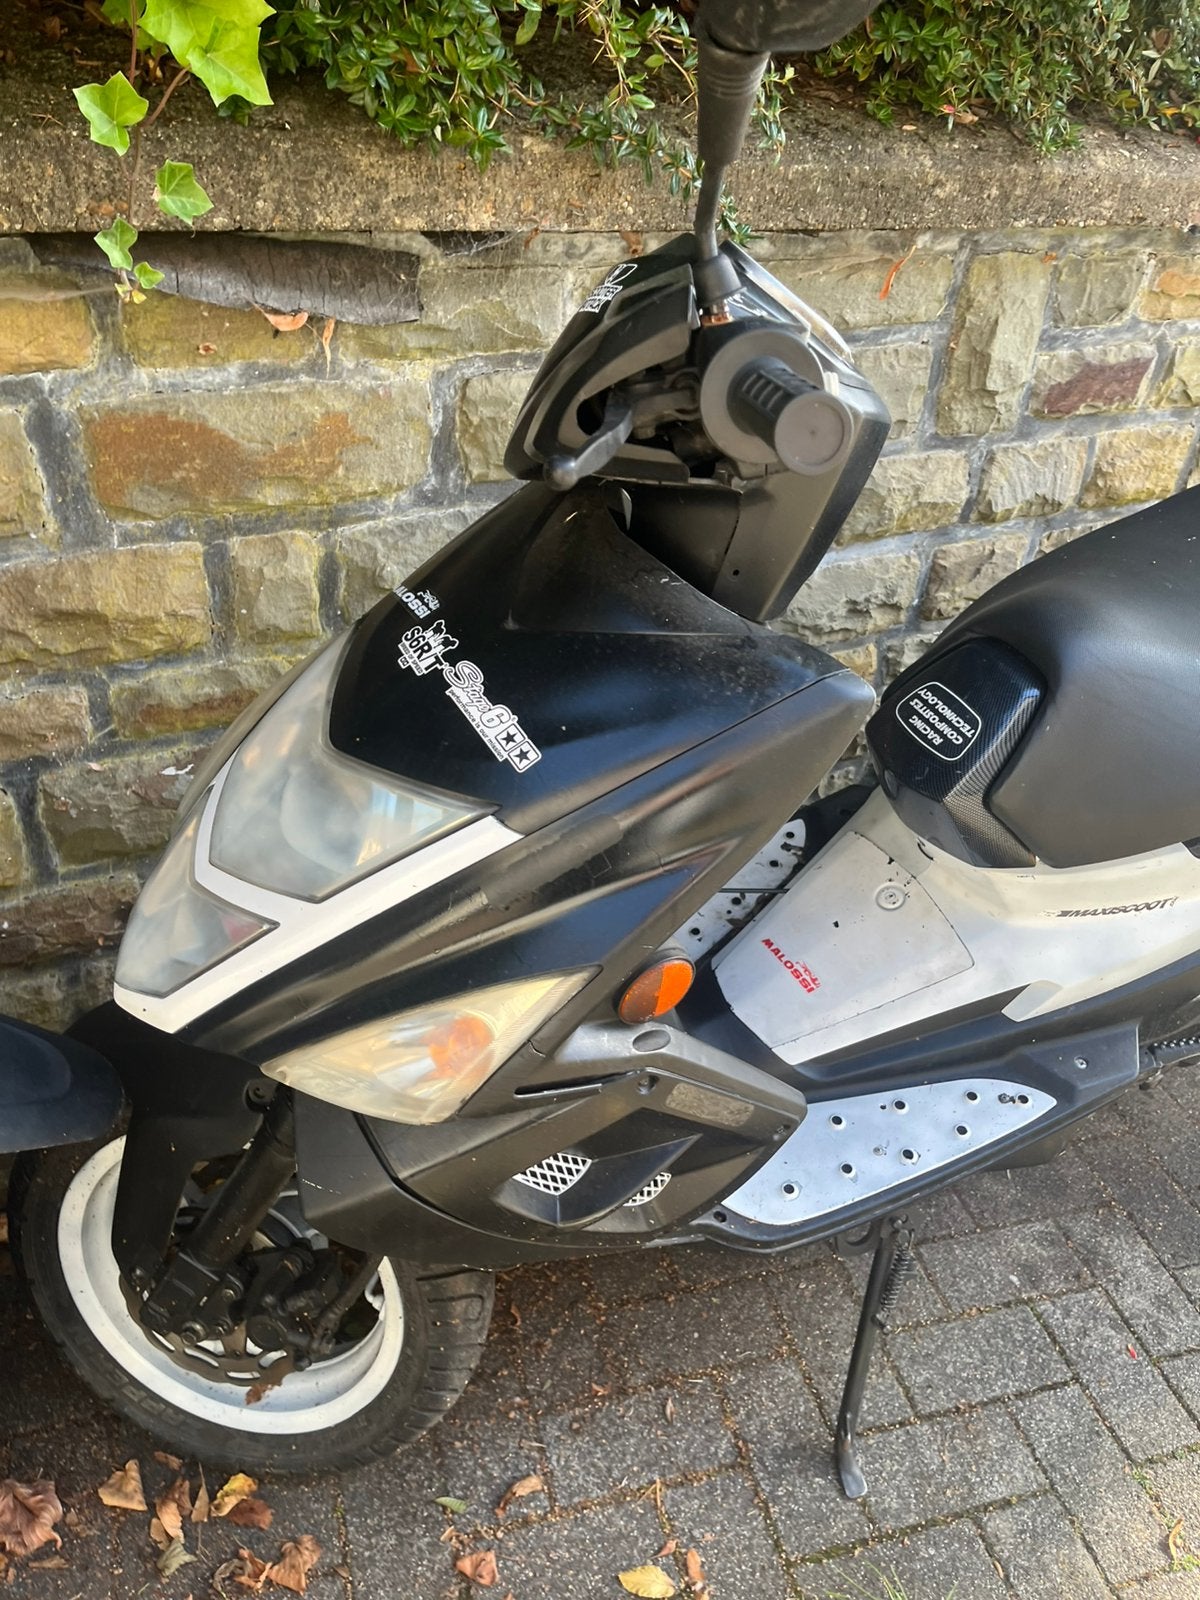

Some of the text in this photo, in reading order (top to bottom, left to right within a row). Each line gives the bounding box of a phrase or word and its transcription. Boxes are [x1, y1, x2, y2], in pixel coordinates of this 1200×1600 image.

[448, 689, 477, 723] performance
[480, 728, 489, 738] our
[487, 738, 505, 760] mission
[908, 715, 944, 746] RACING
[909, 698, 964, 745] COMPOSITES
[917, 688, 976, 738] TECHNOLOGY
[761, 938, 815, 993] MALOSSI
